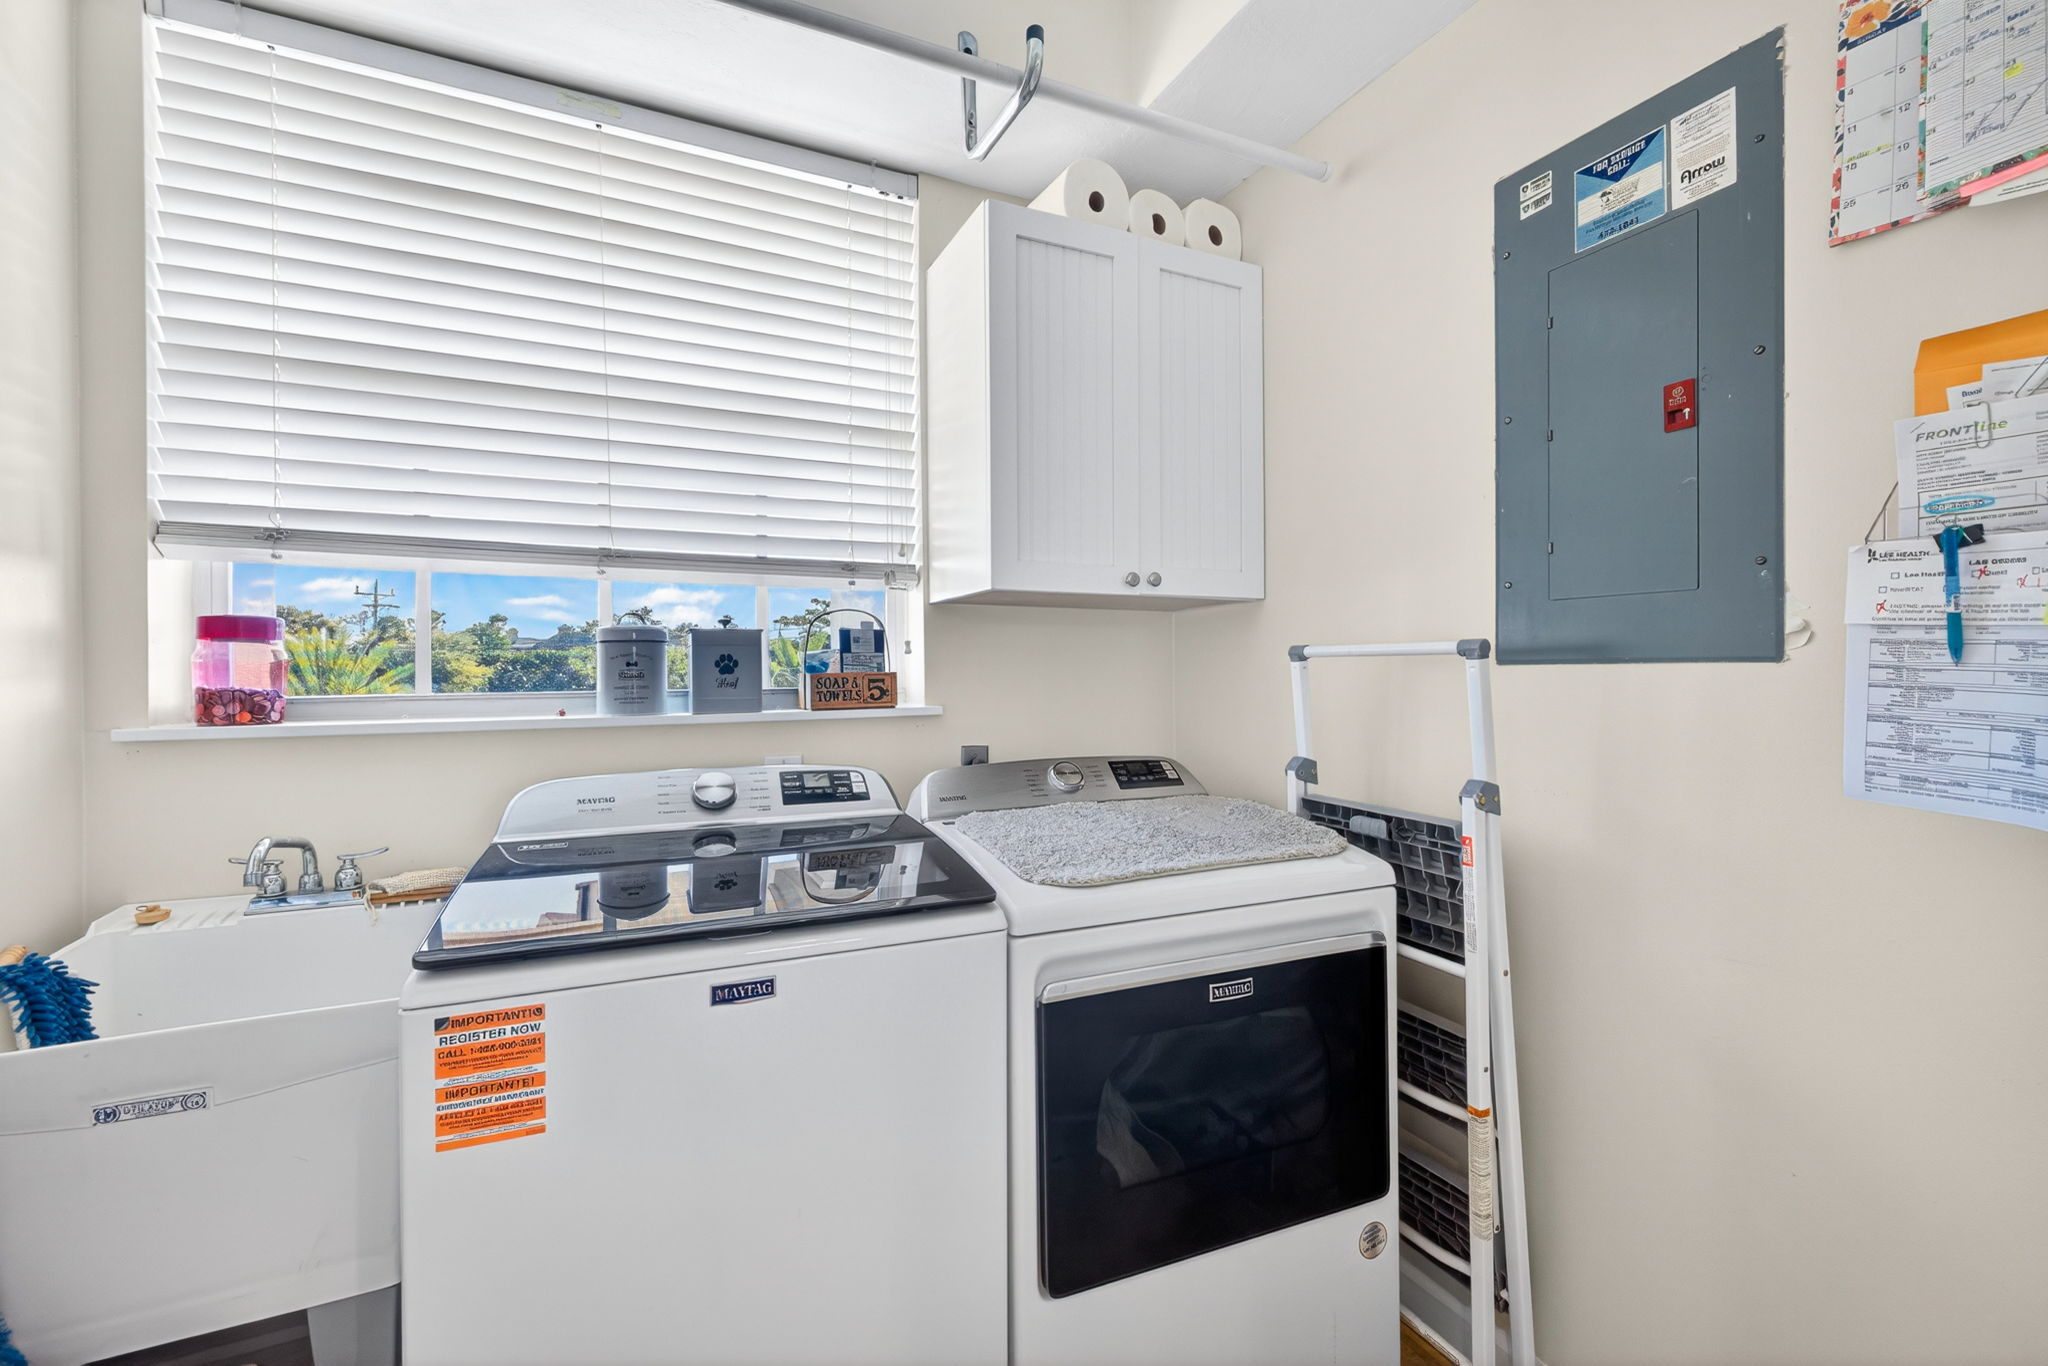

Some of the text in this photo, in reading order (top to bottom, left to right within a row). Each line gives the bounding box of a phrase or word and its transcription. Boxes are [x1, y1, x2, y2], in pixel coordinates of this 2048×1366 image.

[1681, 156, 1725, 184] Arrow
[816, 676, 849, 690] SOAP
[816, 690, 862, 703] TOWELS
[715, 982, 772, 1001] MAYTAG
[440, 1028, 506, 1046] REGISTER
[510, 1023, 542, 1035] NOW
[438, 1049, 466, 1060] CALL
